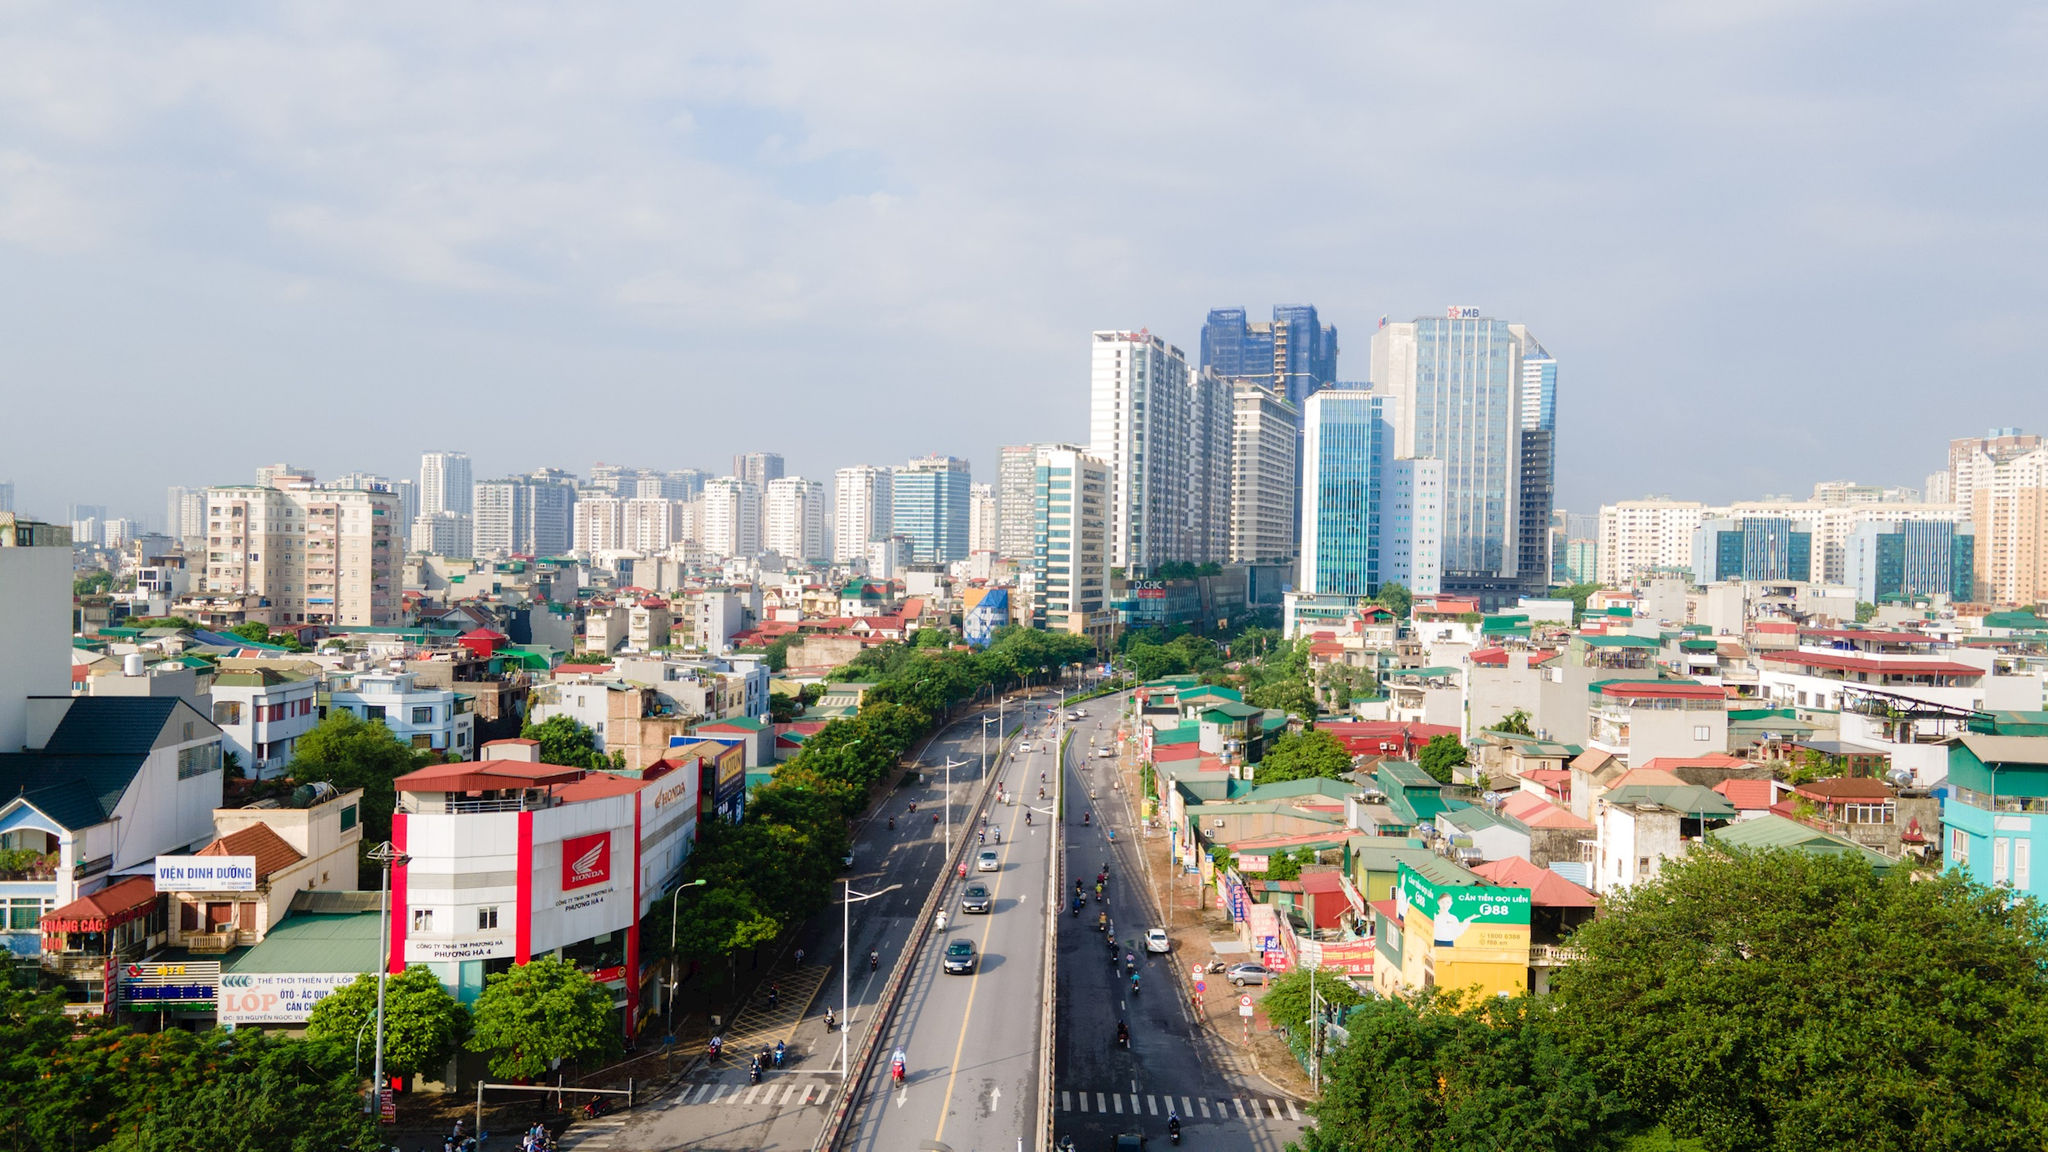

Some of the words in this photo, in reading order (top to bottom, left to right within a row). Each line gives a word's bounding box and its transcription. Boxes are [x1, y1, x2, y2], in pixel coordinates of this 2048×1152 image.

[1462, 308, 1480, 318] MB
[1134, 580, 1162, 589] D.CHIC
[662, 782, 685, 806] HONDA
[160, 866, 184, 880] VIỆN
[188, 868, 213, 879] DINH
[217, 864, 252, 879] DƯỠNG
[572, 870, 604, 882] HONDA
[1458, 892, 1476, 901] CẦN
[1495, 896, 1511, 904] GỌI
[565, 901, 590, 912] PHƯƠNG
[1480, 903, 1509, 916] F88
[225, 985, 278, 1012] LỐP
[314, 990, 329, 999] QUY
